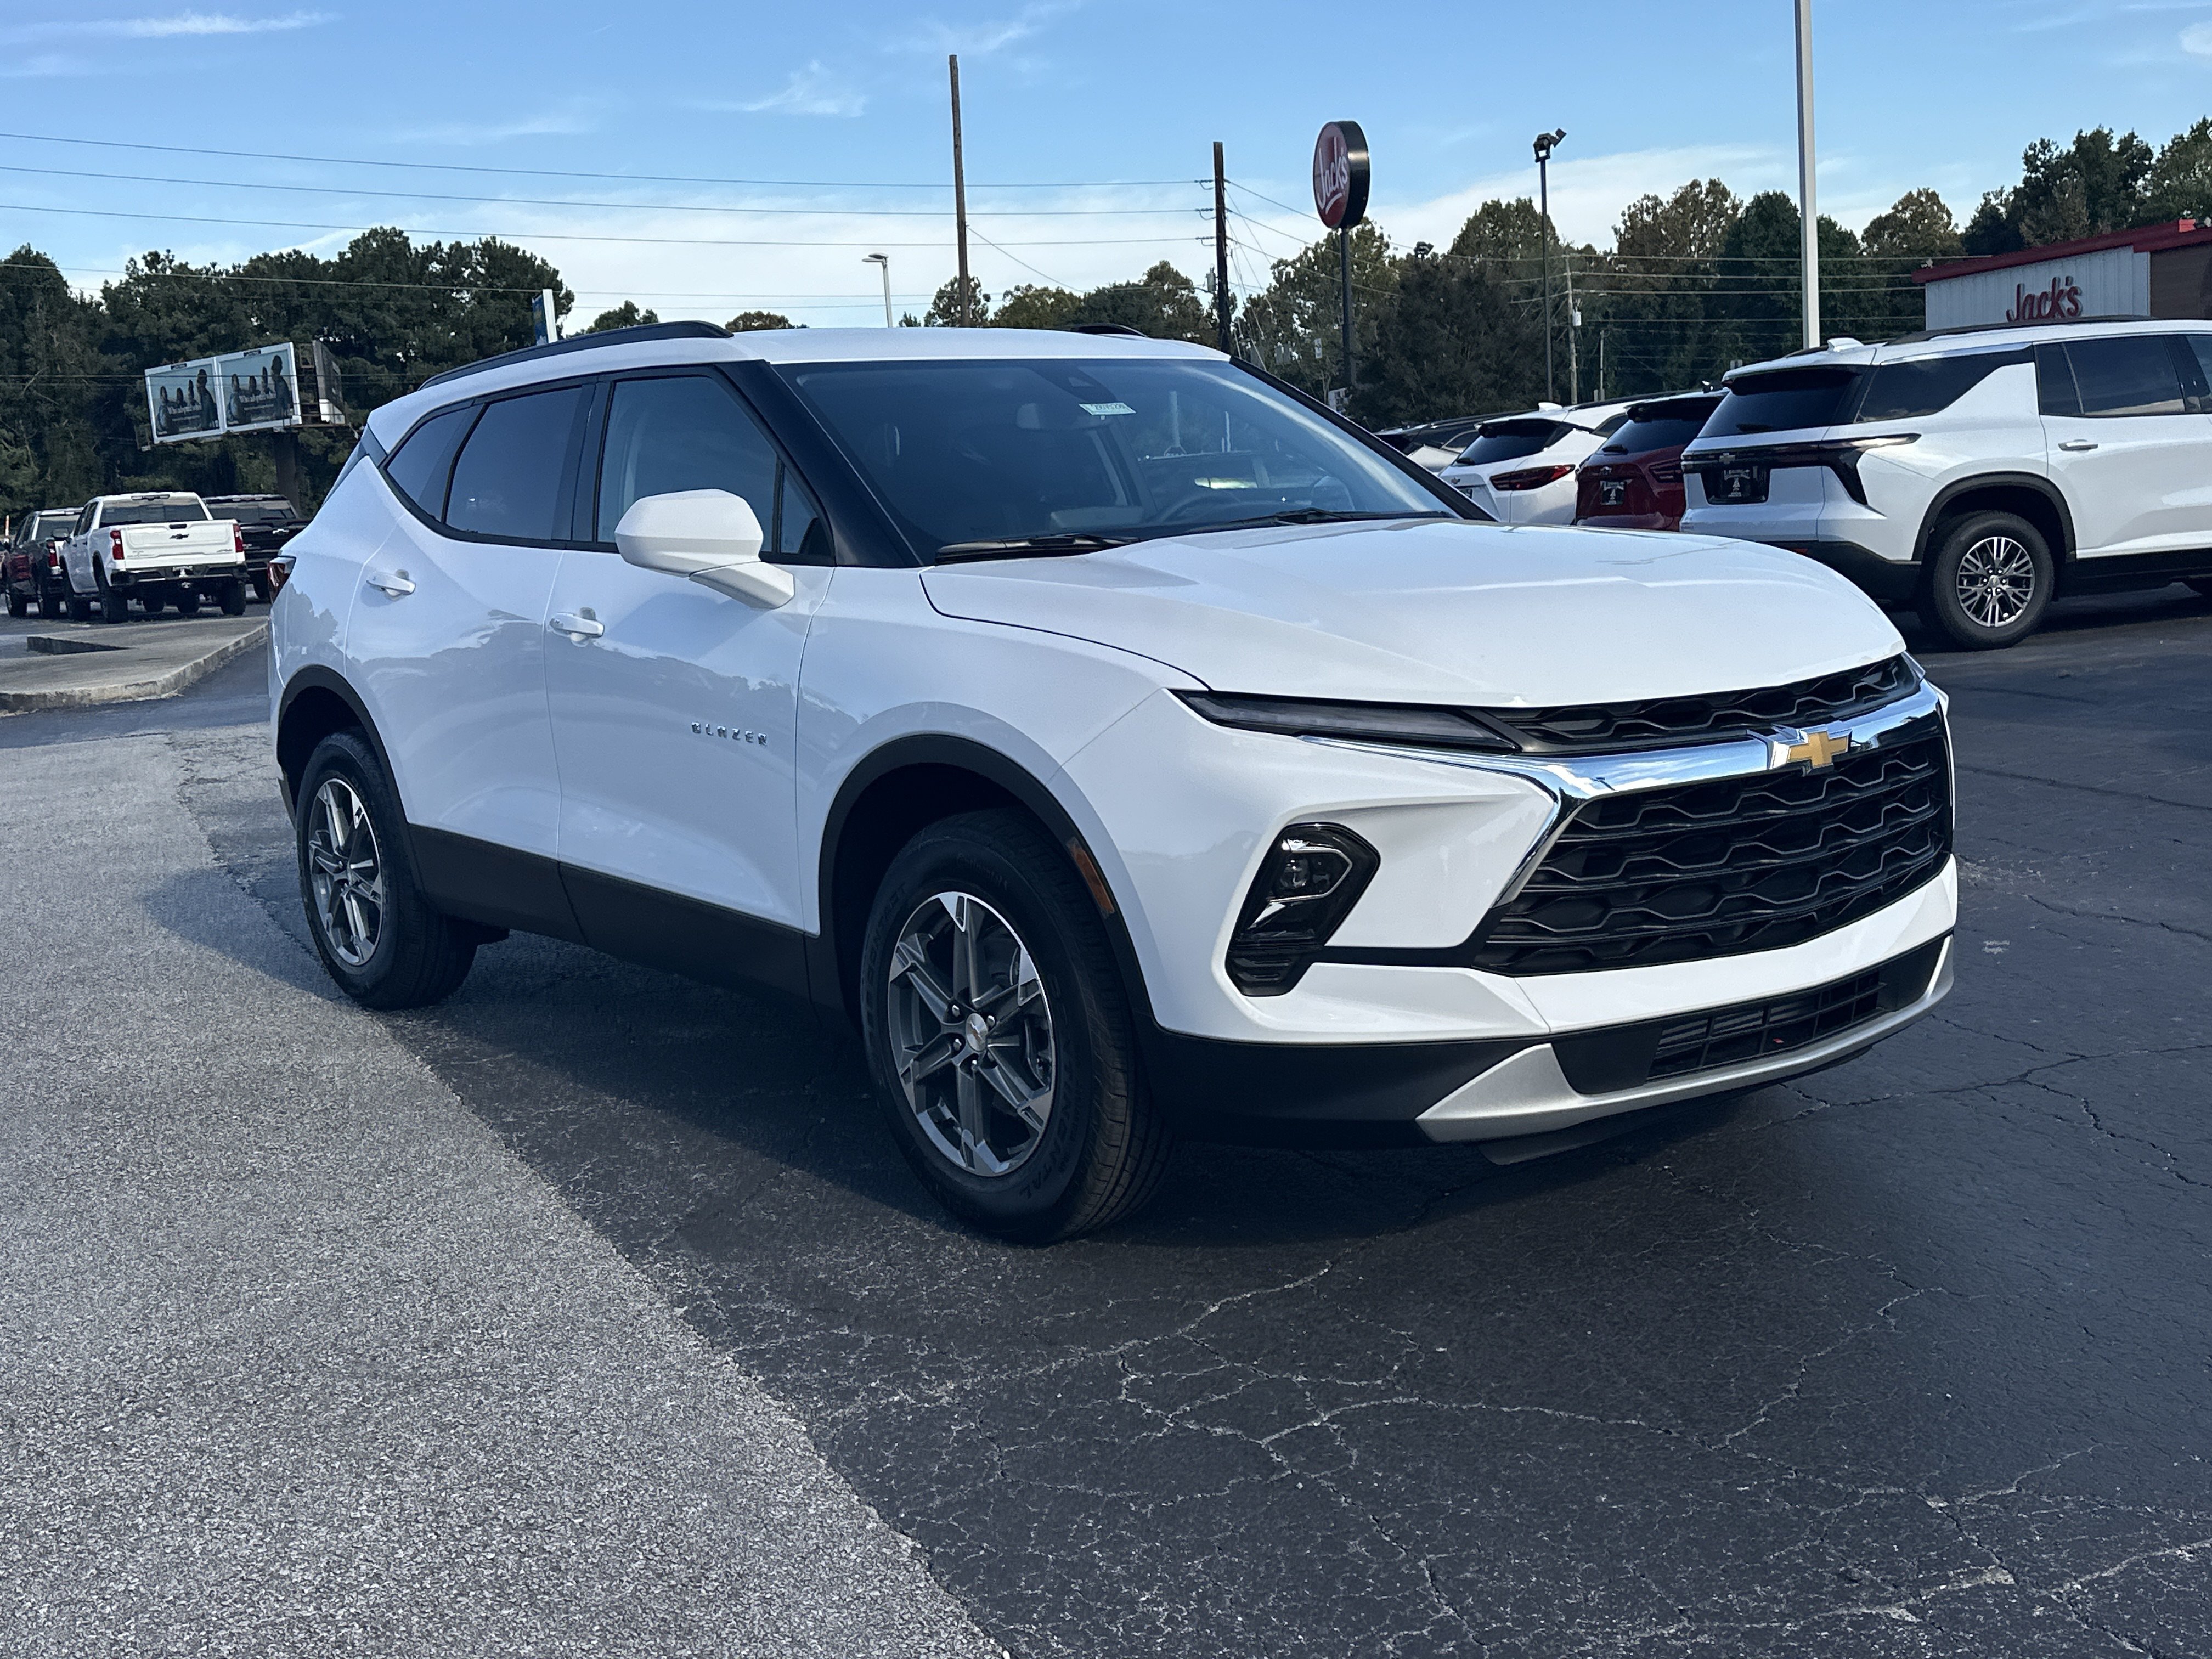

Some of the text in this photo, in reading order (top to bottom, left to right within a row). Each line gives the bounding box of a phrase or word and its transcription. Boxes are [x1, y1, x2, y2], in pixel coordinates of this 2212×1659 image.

[1317, 137, 1348, 210] Jack's
[2006, 275, 2083, 322] Jack's
[691, 721, 768, 746] BLAZER
